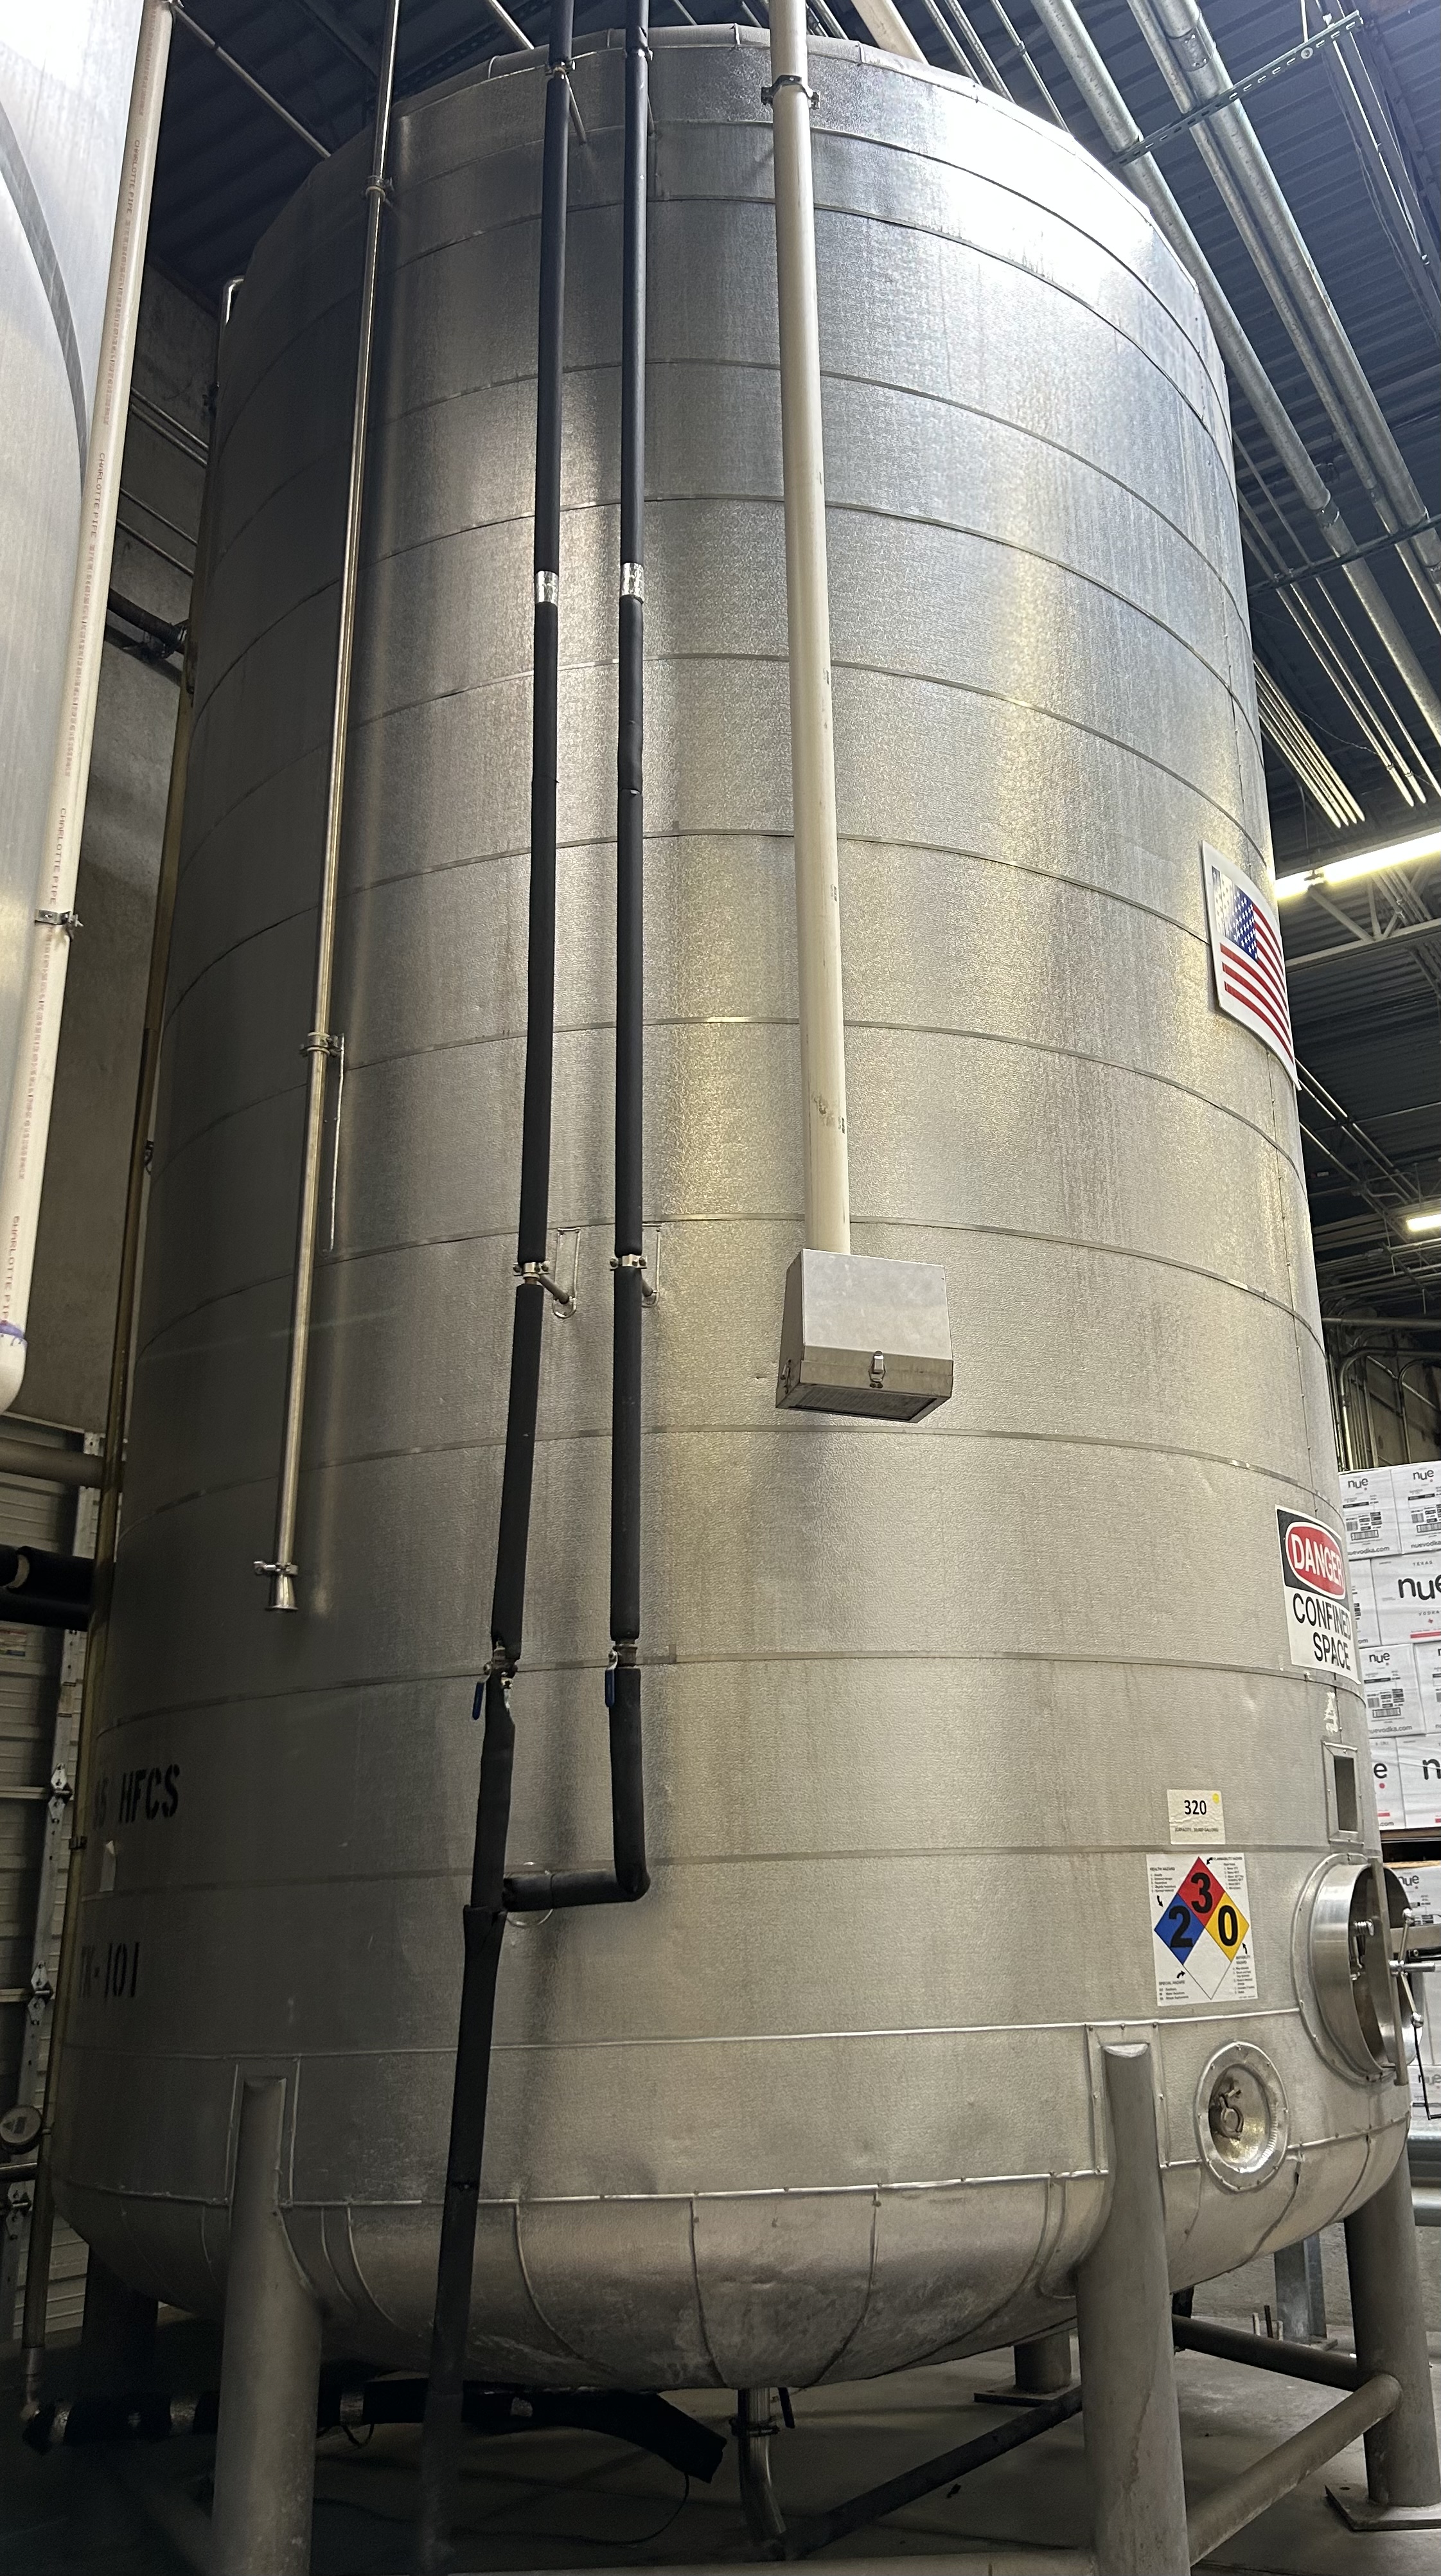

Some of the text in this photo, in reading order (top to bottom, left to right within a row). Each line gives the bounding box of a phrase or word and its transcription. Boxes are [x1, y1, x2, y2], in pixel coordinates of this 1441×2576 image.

[129, 139, 140, 189] CHARLOTTE
[91, 453, 105, 537] CHARLOTTE PIPE
[50, 808, 66, 905] CHARLOTTE PIPE
[1348, 1478, 1368, 1489] nue
[1413, 1470, 1434, 1480] nue
[1291, 1533, 1345, 1588] DANGER
[1293, 1593, 1351, 1640] CONFINED
[1313, 1632, 1351, 1671] SPACE
[1369, 1653, 1390, 1663] nue
[119, 1764, 180, 1824] HFCS
[1184, 1800, 1207, 1815] 320
[1190, 1872, 1213, 1914] 3
[1169, 1905, 1193, 1948] 2
[1218, 1905, 1238, 1946] 0
